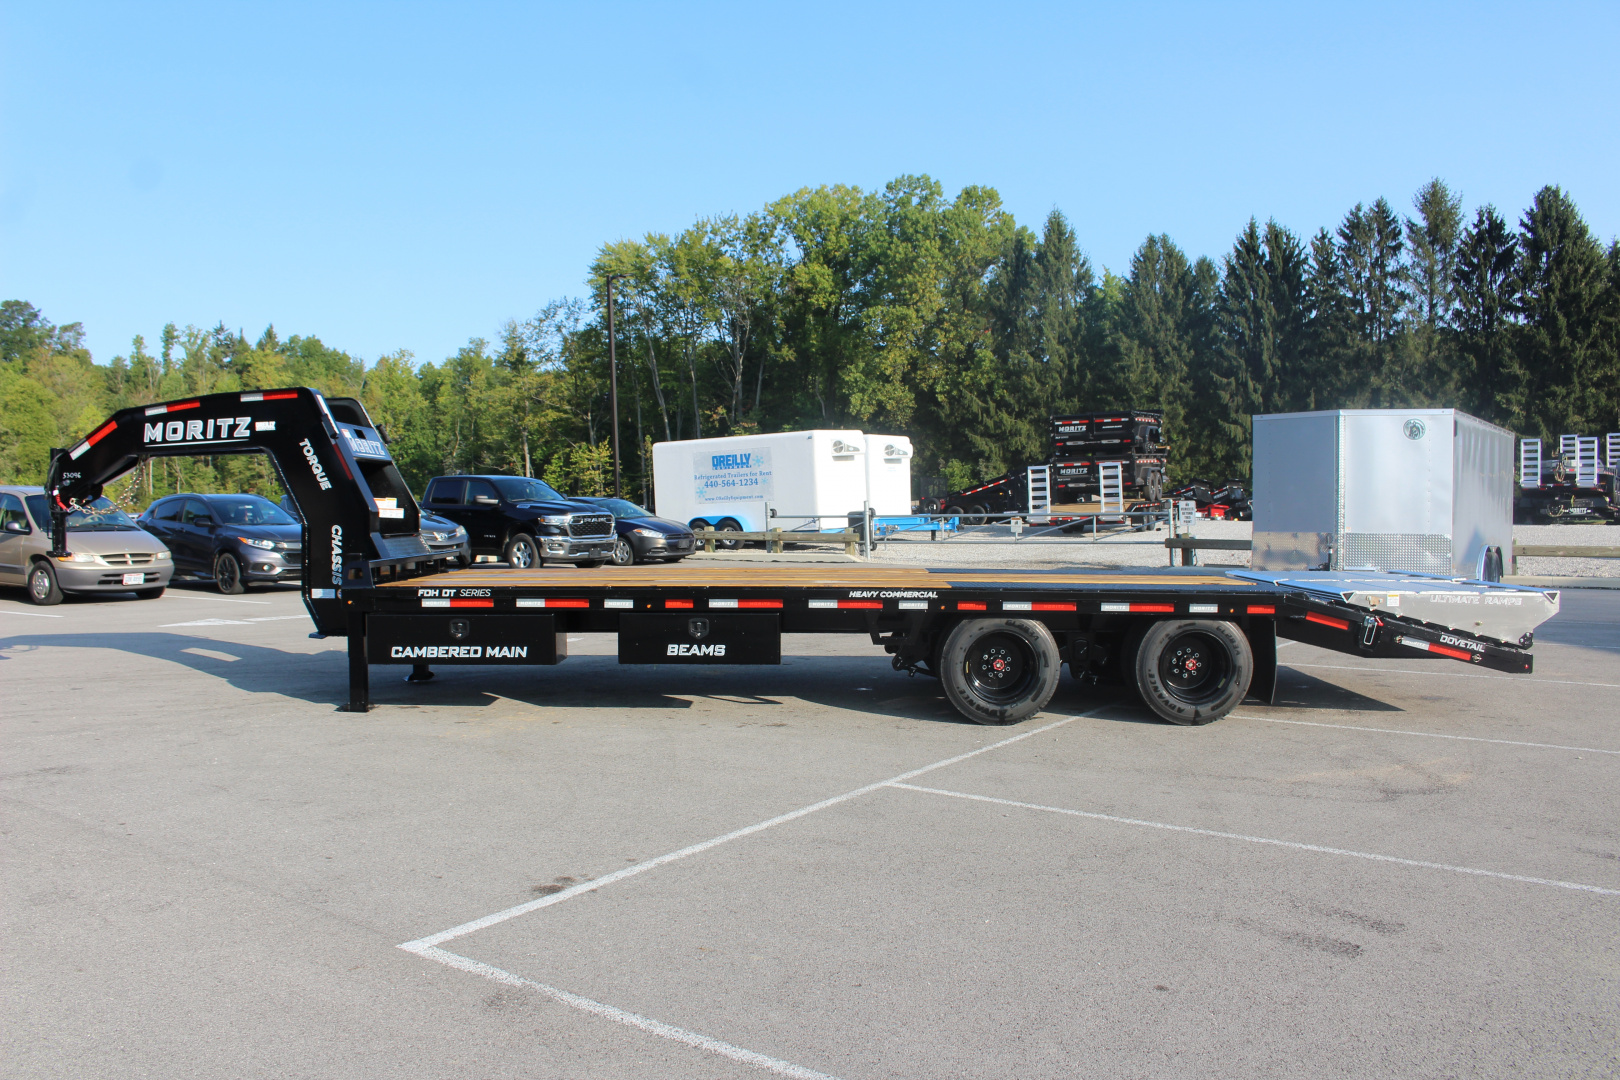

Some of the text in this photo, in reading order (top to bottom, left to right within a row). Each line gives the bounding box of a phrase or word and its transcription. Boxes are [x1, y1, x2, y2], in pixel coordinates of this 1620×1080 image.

[143, 417, 251, 442] MORITZ
[349, 438, 386, 456] MORITZ
[299, 438, 333, 491] TORQUE
[727, 471, 749, 479] Trailers
[704, 478, 759, 488] 440-564-1234
[331, 524, 342, 586] CHASSIS
[459, 589, 492, 597] SERIES
[848, 590, 939, 599] HEAVY COMMERCIAL
[1430, 594, 1522, 606] ULTIMATE RAMPS
[1439, 634, 1485, 652] DOVETAIL
[390, 646, 528, 658] CAMBERED MAIN
[666, 643, 726, 656] BEAMS
